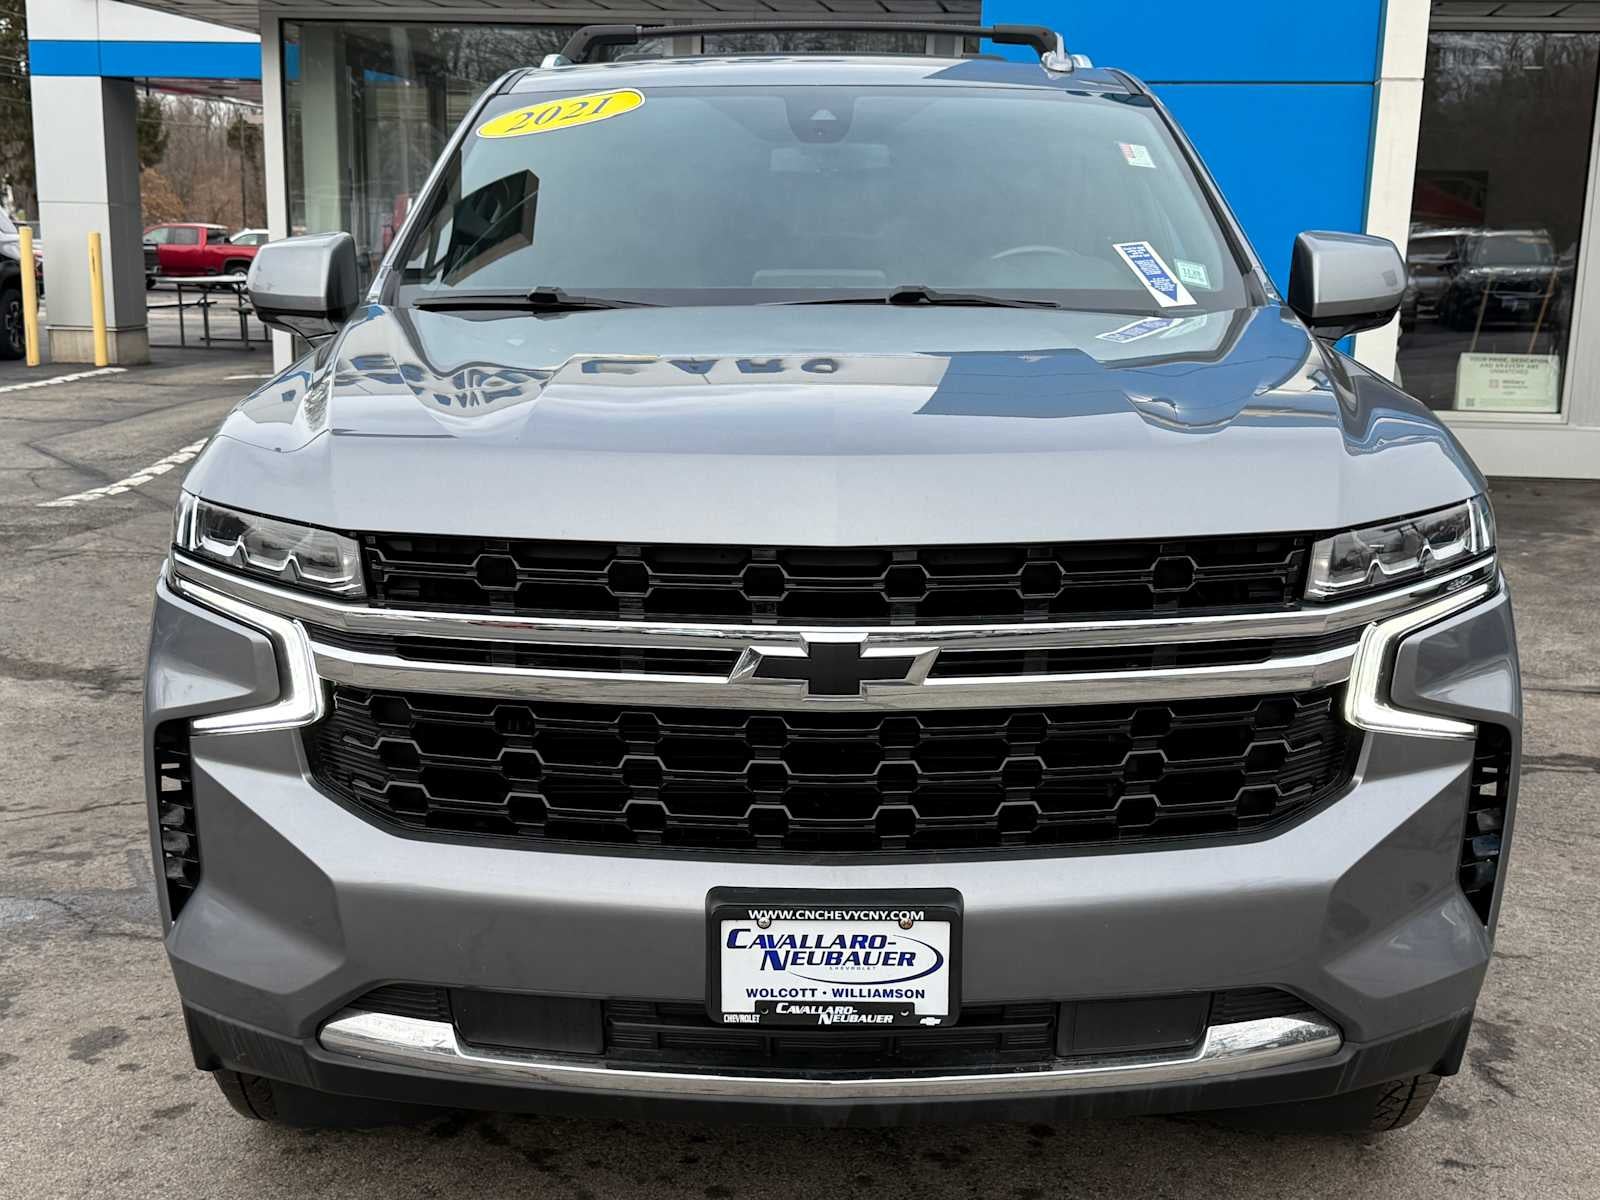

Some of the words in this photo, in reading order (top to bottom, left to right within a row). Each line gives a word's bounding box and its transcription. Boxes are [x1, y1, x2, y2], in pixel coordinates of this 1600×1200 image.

[505, 97, 613, 133] 2021
[748, 909, 925, 921] WWW.CNCHEVYCNY.COM
[726, 928, 897, 949] CAVALLARO-
[760, 950, 917, 971] NEUBAUER
[746, 988, 818, 998] WOLCOTT
[831, 988, 925, 999] WILLIAMSON
[776, 1002, 858, 1015] CAVALLARO-
[723, 1014, 761, 1024] CHEVROLET
[818, 1012, 894, 1025] NEUBAUER
